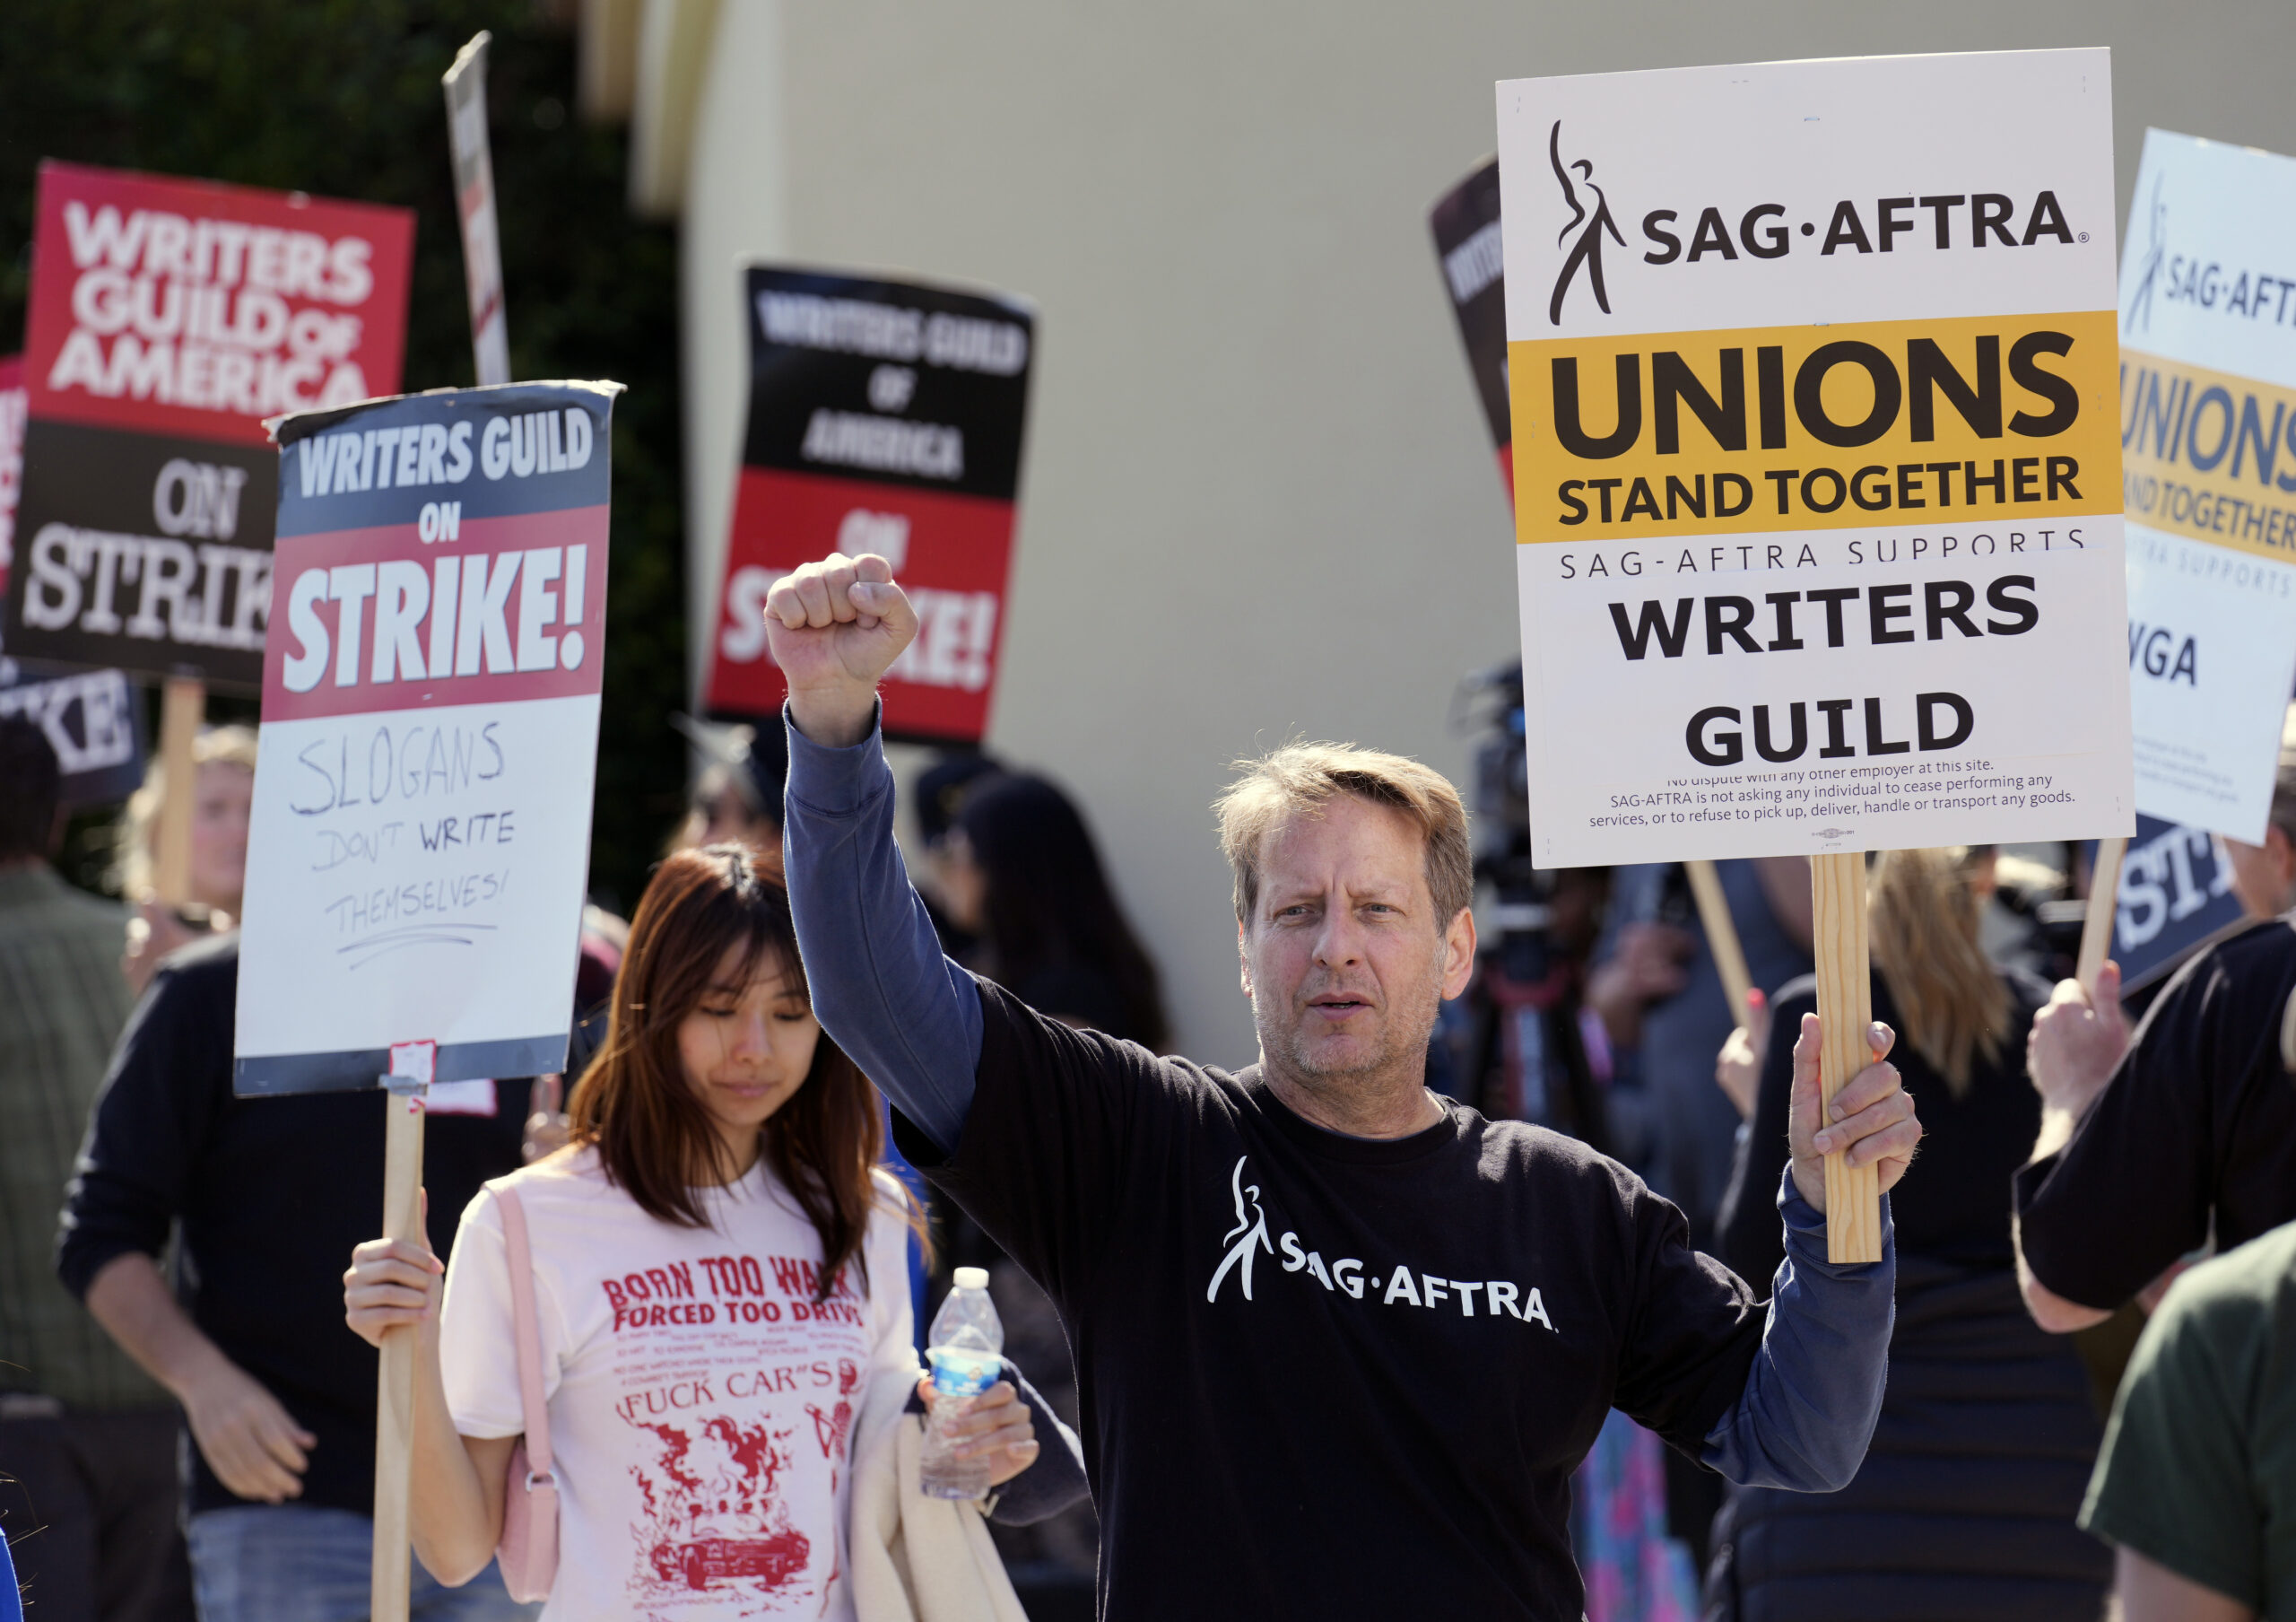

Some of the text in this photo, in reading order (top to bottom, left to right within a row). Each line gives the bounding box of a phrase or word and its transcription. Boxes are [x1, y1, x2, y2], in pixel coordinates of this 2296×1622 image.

[64, 199, 373, 306] WRITERS
[72, 268, 364, 361] GUILD OF
[48, 327, 369, 416] AMERICA
[1551, 331, 2080, 460] UNIONS
[299, 407, 594, 498] WRITERS GUILD
[152, 458, 248, 541] ON
[418, 501, 461, 544] ON
[1558, 456, 2083, 526] STAND TOGETHER
[22, 521, 274, 654] STRIK
[1561, 528, 2084, 580] SAG-AFTRA SUPPORTS
[282, 543, 587, 693] STRIKE!
[1608, 575, 2039, 661] WRITERS
[1685, 693, 1974, 767] GUILD
[289, 721, 504, 816] SLOGANS
[1610, 774, 2053, 808] SAG-AFTRA is not asking any individual to cease performing any
[1780, 772, 1805, 785] any
[1808, 769, 1848, 782] other
[1849, 764, 1915, 780] employer
[1918, 763, 1933, 774] at
[1935, 760, 1962, 773] this
[1965, 759, 1995, 772] site.
[420, 810, 514, 851] WRITE
[1589, 789, 2076, 827] services, or to refuse to pick up, deliver, handle or transport any goods.
[602, 1254, 858, 1313] BORN TOO WAK
[612, 1303, 717, 1333] FORCED
[724, 1301, 782, 1323] TOO
[624, 1378, 715, 1418] FUCK
